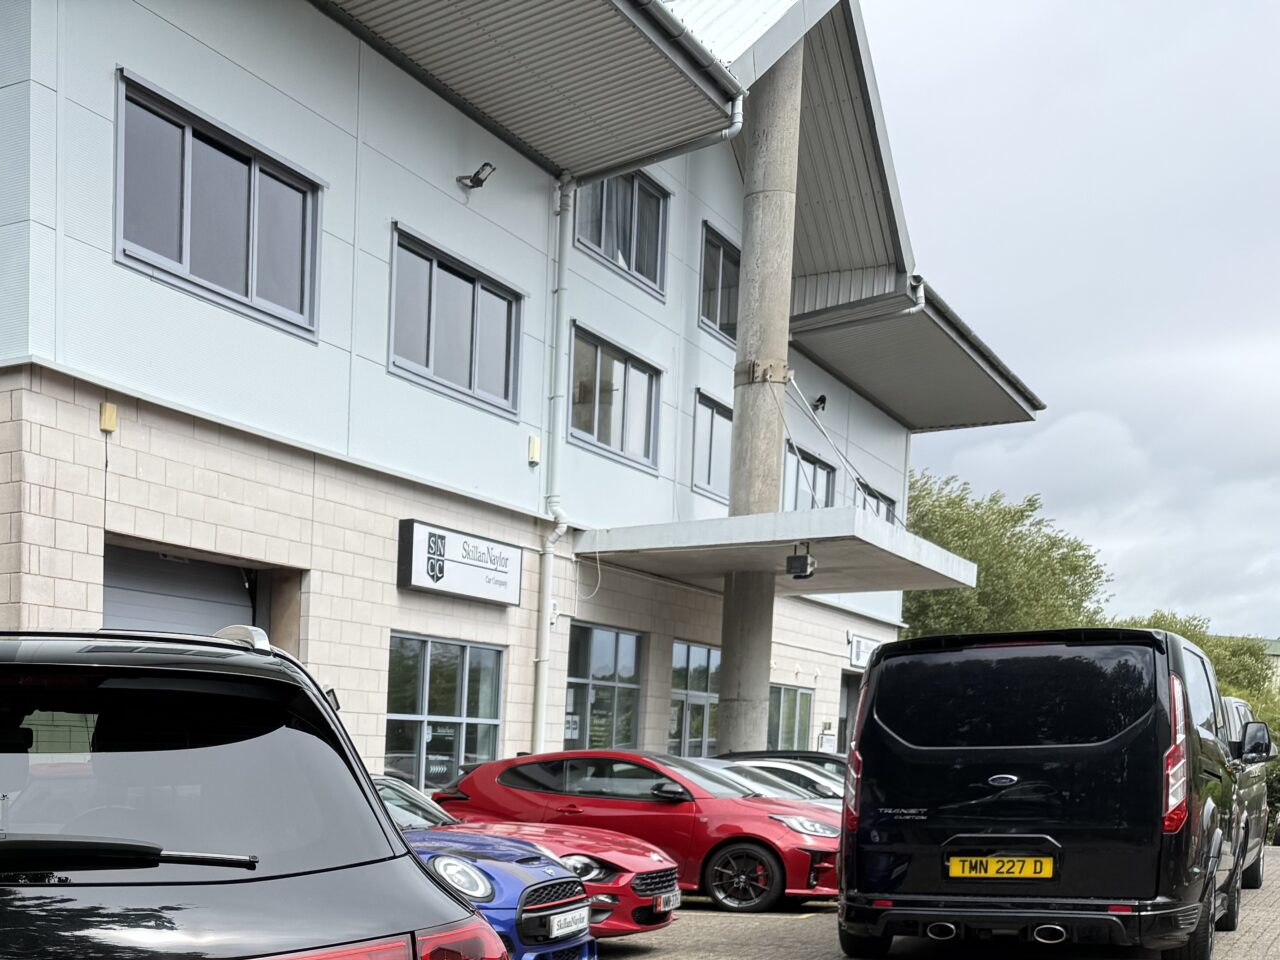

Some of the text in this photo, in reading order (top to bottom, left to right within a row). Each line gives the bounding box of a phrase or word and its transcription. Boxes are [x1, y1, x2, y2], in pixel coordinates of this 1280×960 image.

[462, 540, 509, 570] SkillanNaylor
[959, 859, 1043, 875] TMN 227 D
